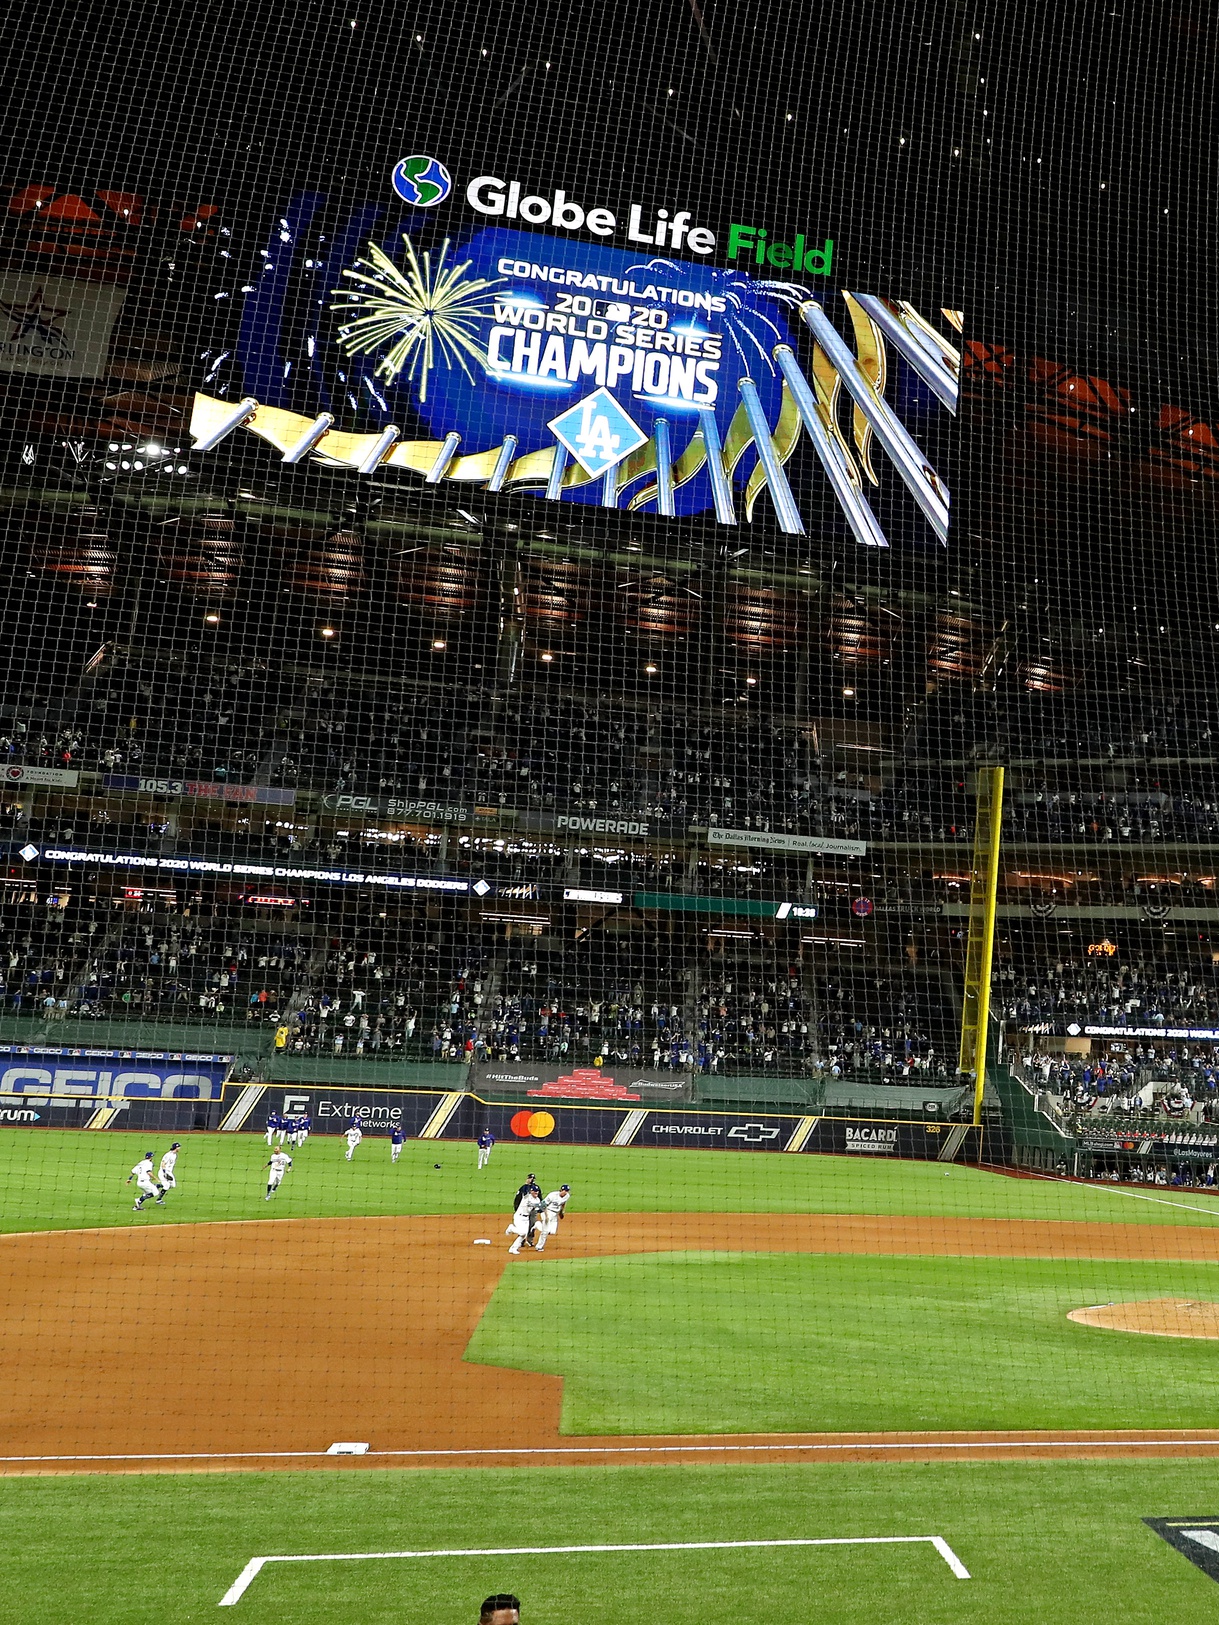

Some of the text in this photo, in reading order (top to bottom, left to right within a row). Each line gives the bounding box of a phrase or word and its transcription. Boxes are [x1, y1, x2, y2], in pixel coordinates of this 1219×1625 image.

[467, 176, 833, 276] Globe Life Field
[498, 259, 726, 312] CONGRATULATIONS
[554, 292, 668, 329] 20 20
[493, 303, 722, 360] WORLD SERIES
[487, 325, 720, 404] CHAMPIONS
[575, 400, 620, 460] LA
[138, 779, 258, 800] 105.3 THE FAN
[337, 795, 378, 810] PGL
[387, 800, 468, 814] ShipPGL.com
[386, 808, 467, 822] 877.701.1919
[557, 816, 649, 836] POWERADE
[712, 832, 724, 840] The
[725, 833, 744, 841] Dallas
[744, 834, 770, 844] Morning
[770, 836, 786, 845] News
[45, 850, 469, 891] CONGRATULATIONS 2020 WORLD SERIES CHAMPIONS LOS ANGELES DODGERS
[1085, 1026, 1166, 1037] CONGRATULATIONS
[1167, 1029, 1188, 1038] 2020
[185, 1054, 213, 1062] GEICO
[0, 1067, 213, 1109] GEICO
[0, 1109, 35, 1122] rum
[318, 1101, 402, 1119] Extreme
[652, 1124, 723, 1136] CHEVROLET
[1174, 1148, 1213, 1159] @LasMayores
